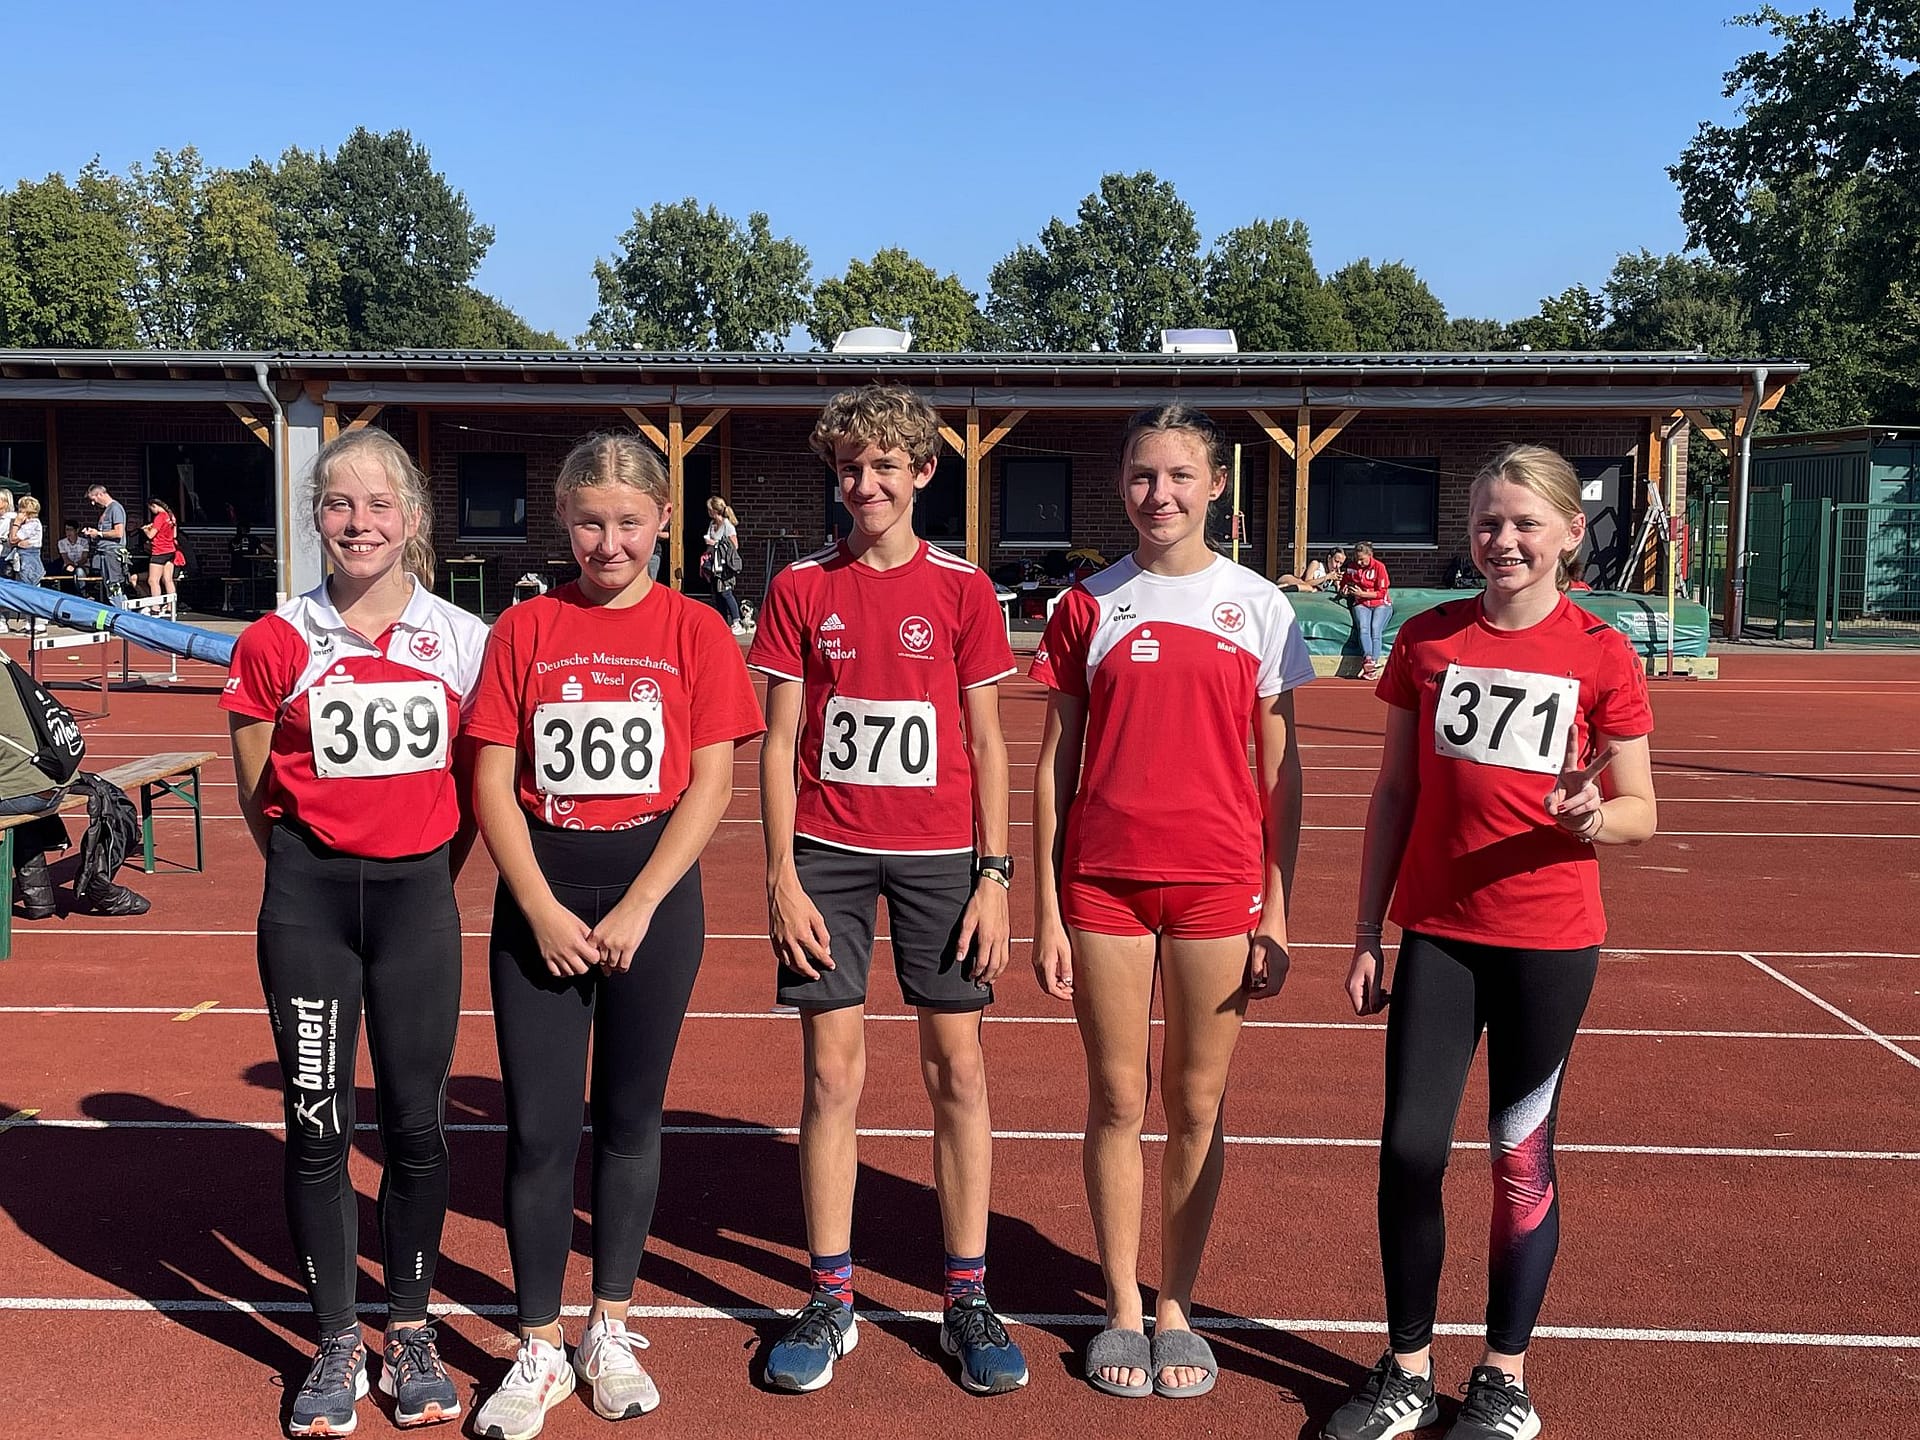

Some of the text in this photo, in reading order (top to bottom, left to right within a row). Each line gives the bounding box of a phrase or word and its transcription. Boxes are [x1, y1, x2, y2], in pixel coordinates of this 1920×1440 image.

[1113, 614, 1136, 622] erima
[536, 652, 679, 676] Deutsche Meisterschaften
[591, 671, 625, 686] Wesel
[320, 696, 440, 764] 369
[542, 717, 653, 782] 368
[829, 711, 930, 774] 370
[1443, 681, 1560, 758] 371
[291, 997, 325, 1091] bunert
[327, 1074, 336, 1089] Der
